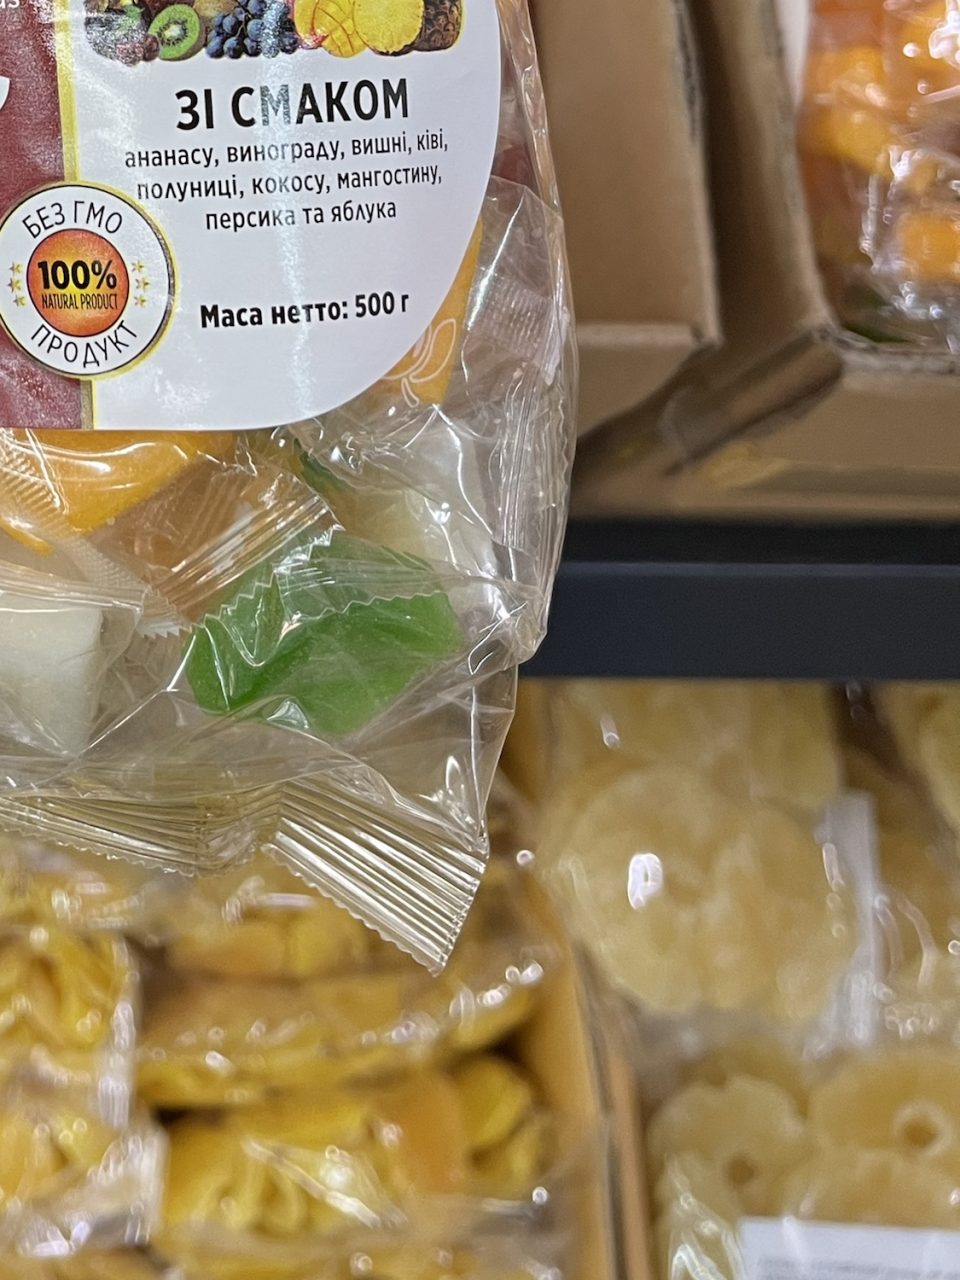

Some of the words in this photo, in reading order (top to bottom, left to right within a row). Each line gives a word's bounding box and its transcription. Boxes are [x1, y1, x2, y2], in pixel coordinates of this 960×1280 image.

[175, 88, 215, 131] ЗІ
[231, 78, 410, 128] СМАКОМ
[125, 146, 220, 169] ананасу,
[226, 138, 345, 164] винограду,
[351, 131, 412, 156] вишні,
[416, 128, 448, 151] ківі,
[137, 174, 244, 200] полуниці,
[251, 172, 331, 196] кокосу,
[337, 163, 442, 190] мангостину,
[21, 202, 66, 239] БЕЗ
[73, 200, 124, 234] ГМО
[205, 206, 296, 233] персика
[302, 206, 325, 225] та
[331, 199, 397, 224] яблука
[37, 259, 118, 291] 100%
[41, 293, 79, 310] NATURAL
[80, 293, 119, 310] PRODUCT
[200, 304, 263, 329] Маса
[271, 301, 349, 325] нетто:
[355, 291, 395, 318] 500
[401, 293, 410, 314] г
[31, 319, 138, 369] ПРОДУКТ
